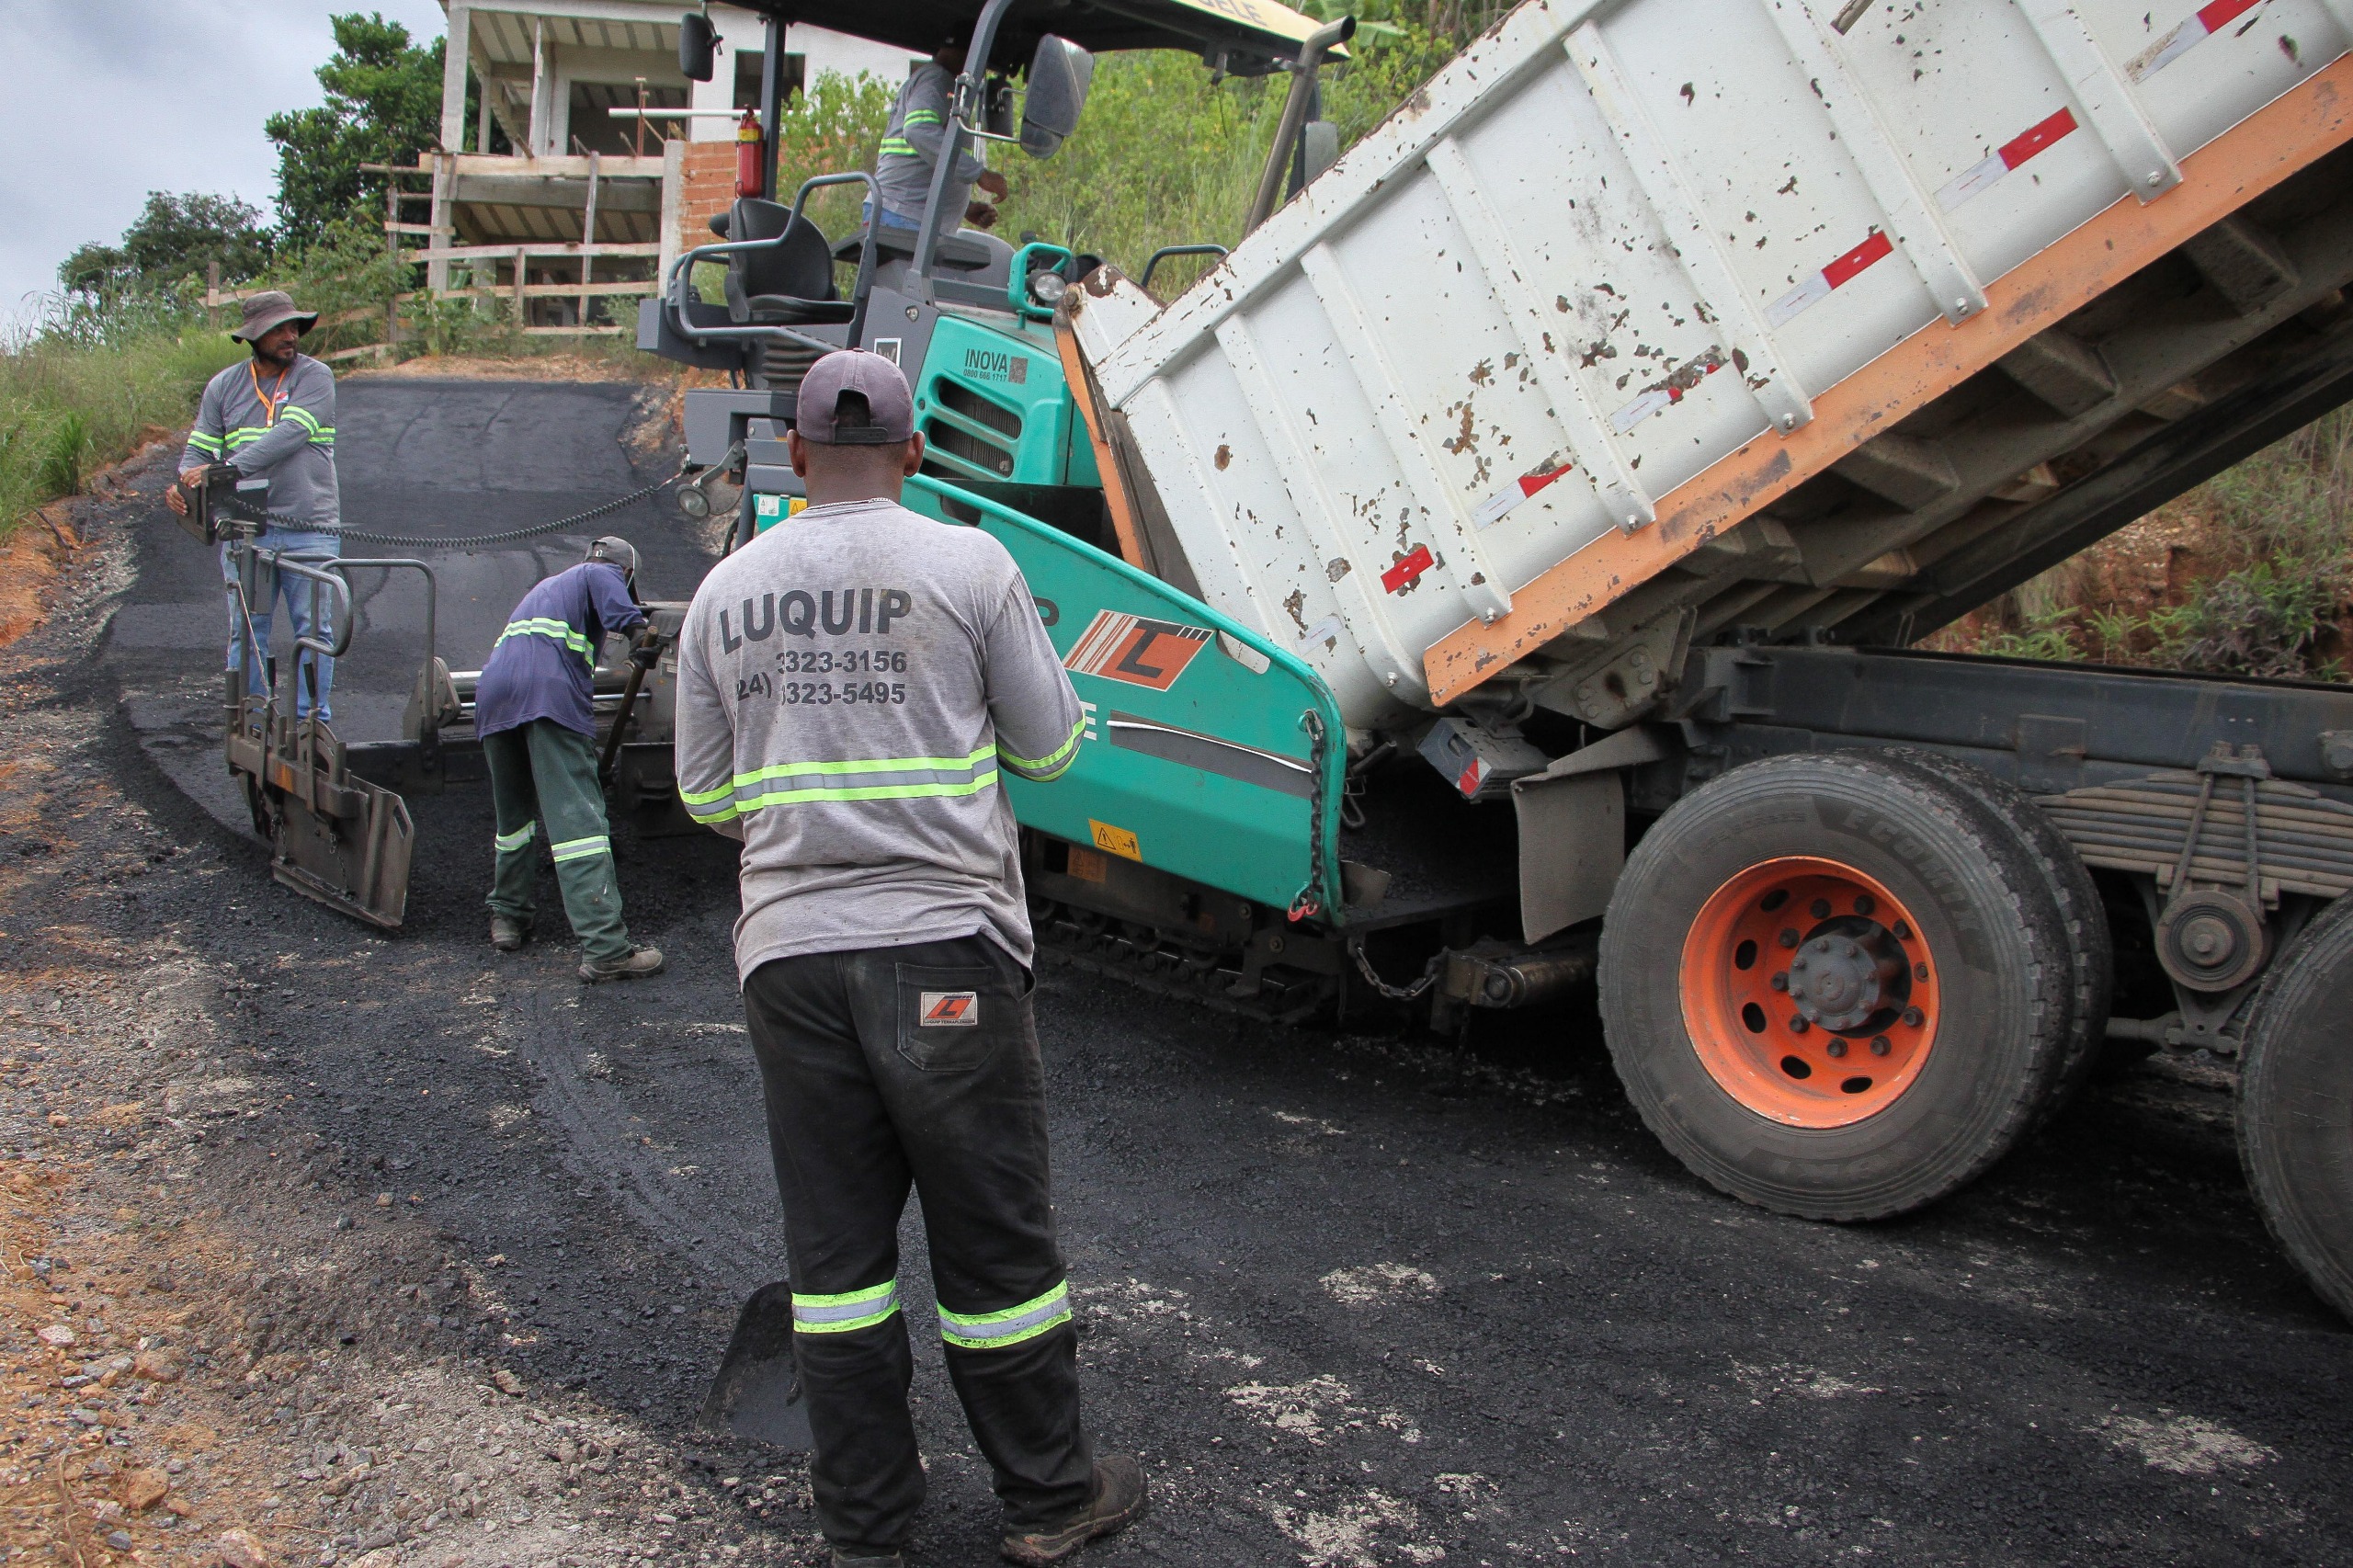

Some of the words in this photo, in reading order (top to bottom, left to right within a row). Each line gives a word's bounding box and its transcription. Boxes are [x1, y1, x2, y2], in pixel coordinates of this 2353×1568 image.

[965, 348, 1007, 373] INOVA
[963, 369, 978, 378] 0800
[992, 373, 1007, 382] 1717
[720, 588, 912, 655] LUQUIP
[781, 682, 905, 706] 323-5495
